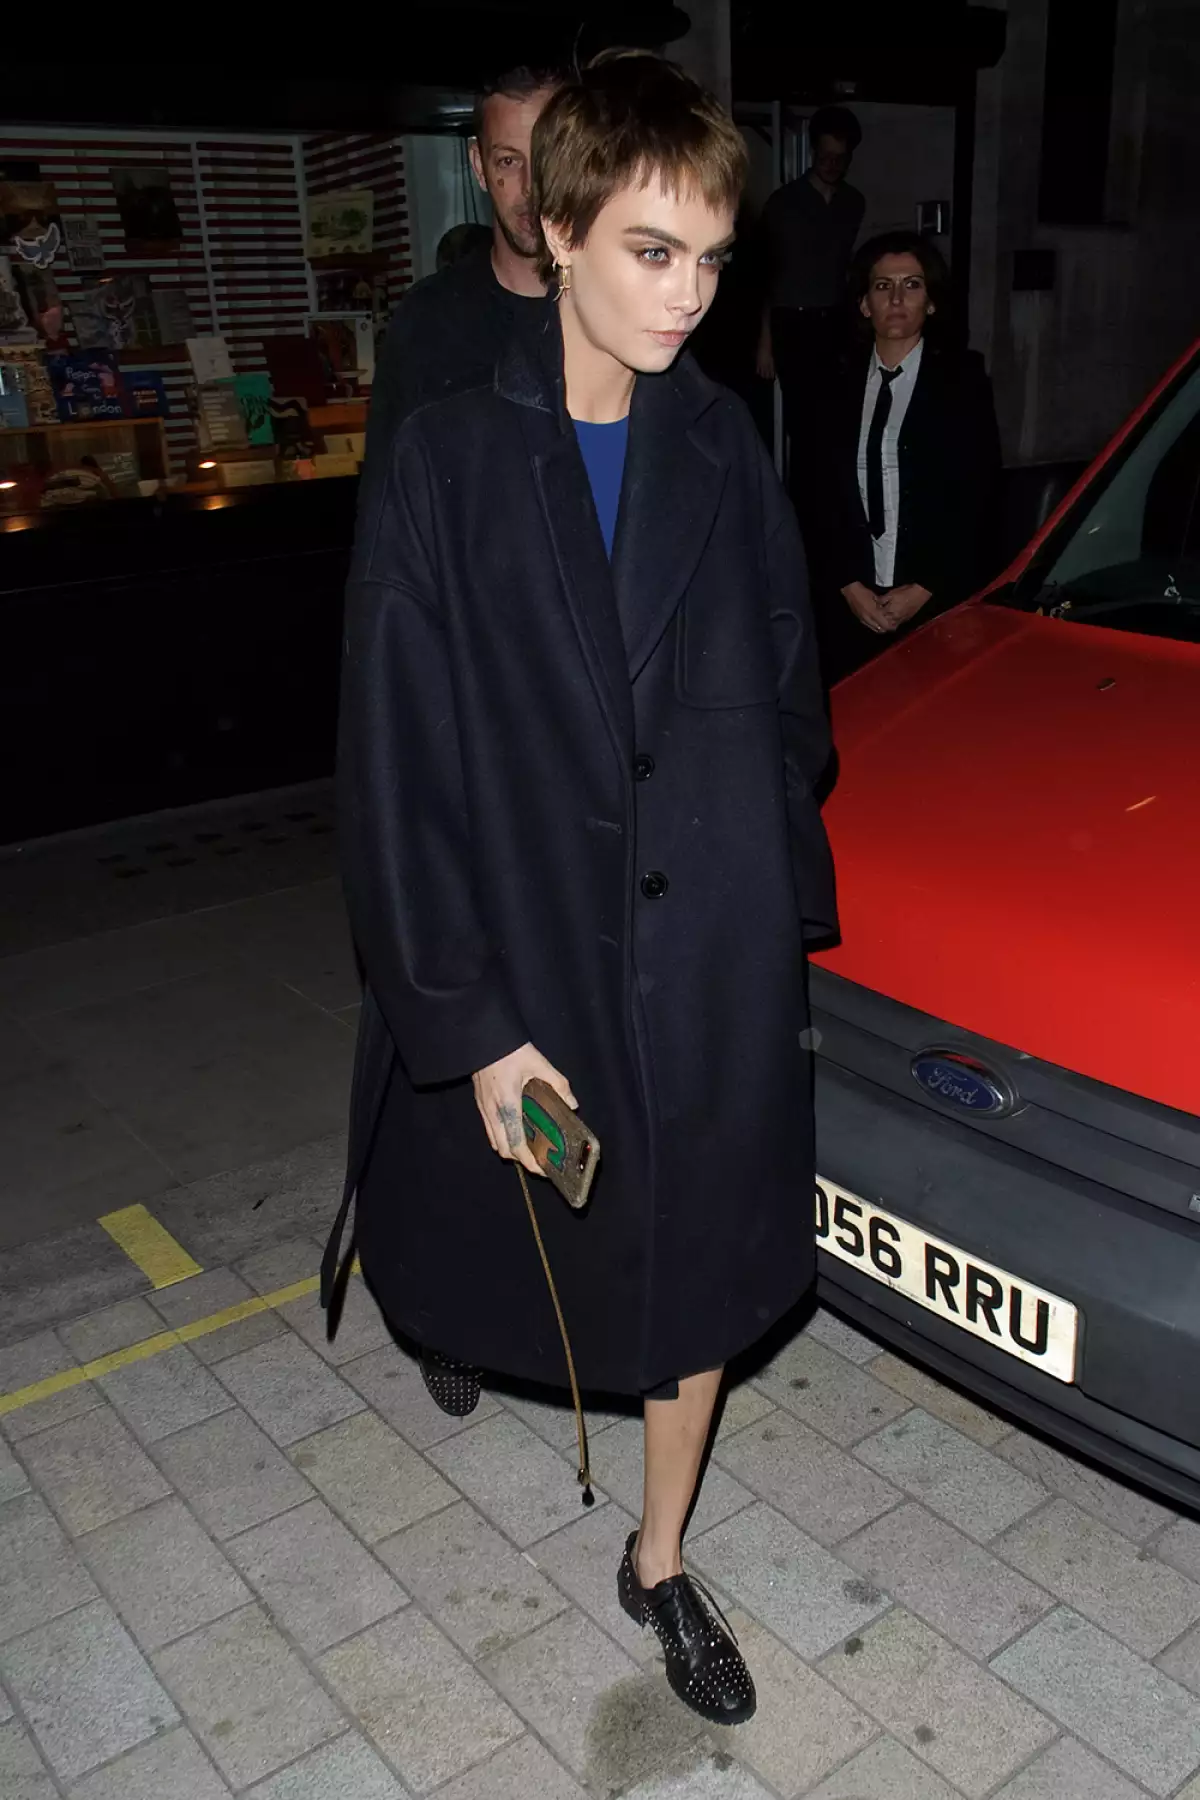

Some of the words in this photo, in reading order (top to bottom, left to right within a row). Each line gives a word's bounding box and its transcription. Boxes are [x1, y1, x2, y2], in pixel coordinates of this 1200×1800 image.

[67, 400, 122, 415] London
[928, 1067, 978, 1105] Ford
[925, 1241, 1049, 1356] RRU
